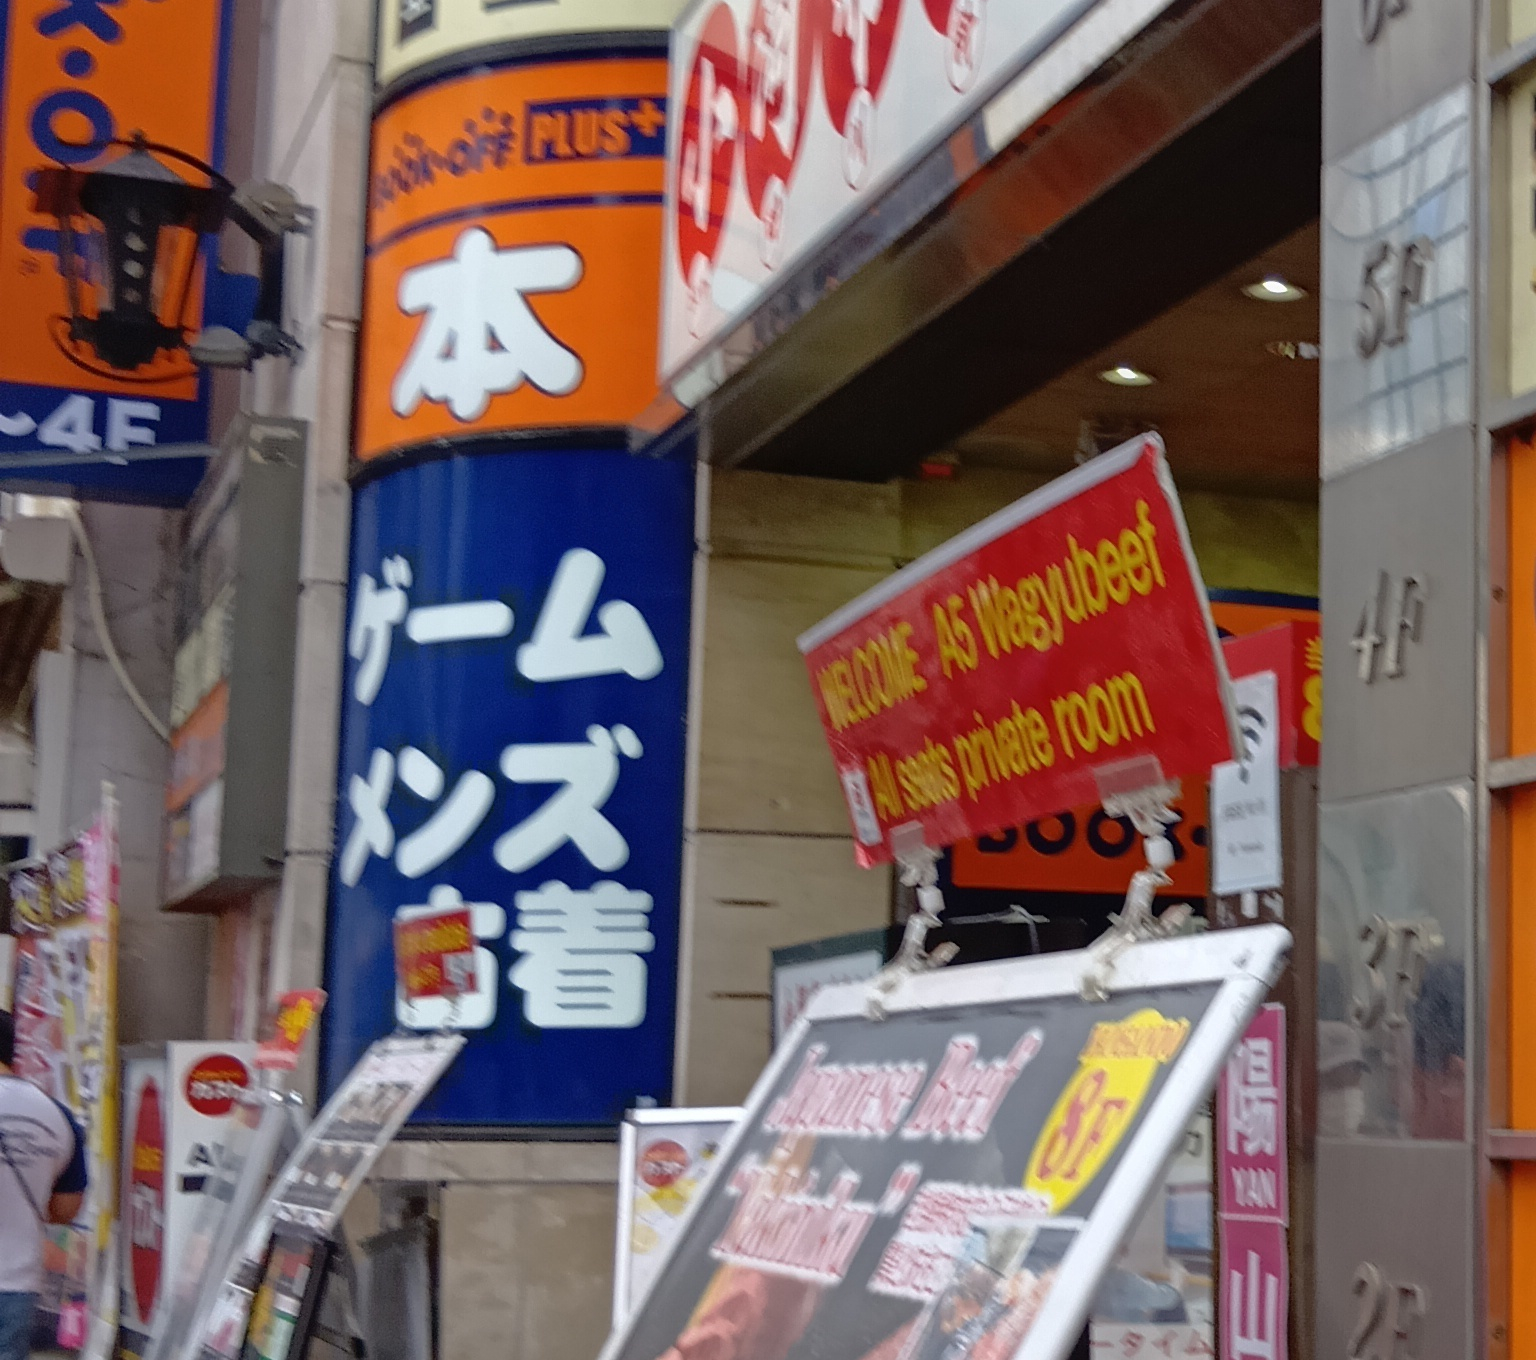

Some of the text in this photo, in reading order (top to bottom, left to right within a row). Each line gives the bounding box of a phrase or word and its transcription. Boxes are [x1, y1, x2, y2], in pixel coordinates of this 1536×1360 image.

[391, 226, 585, 424] 本
[1353, 233, 1435, 360] 5F
[348, 546, 664, 707] ゲーム
[817, 498, 1166, 733] WELCOME A5 Wagyubeef
[1350, 569, 1428, 686] 4F
[340, 723, 645, 889] メンズ
[953, 697, 1054, 808] private
[1052, 670, 1156, 757] room
[1351, 913, 1433, 1032] 3F
